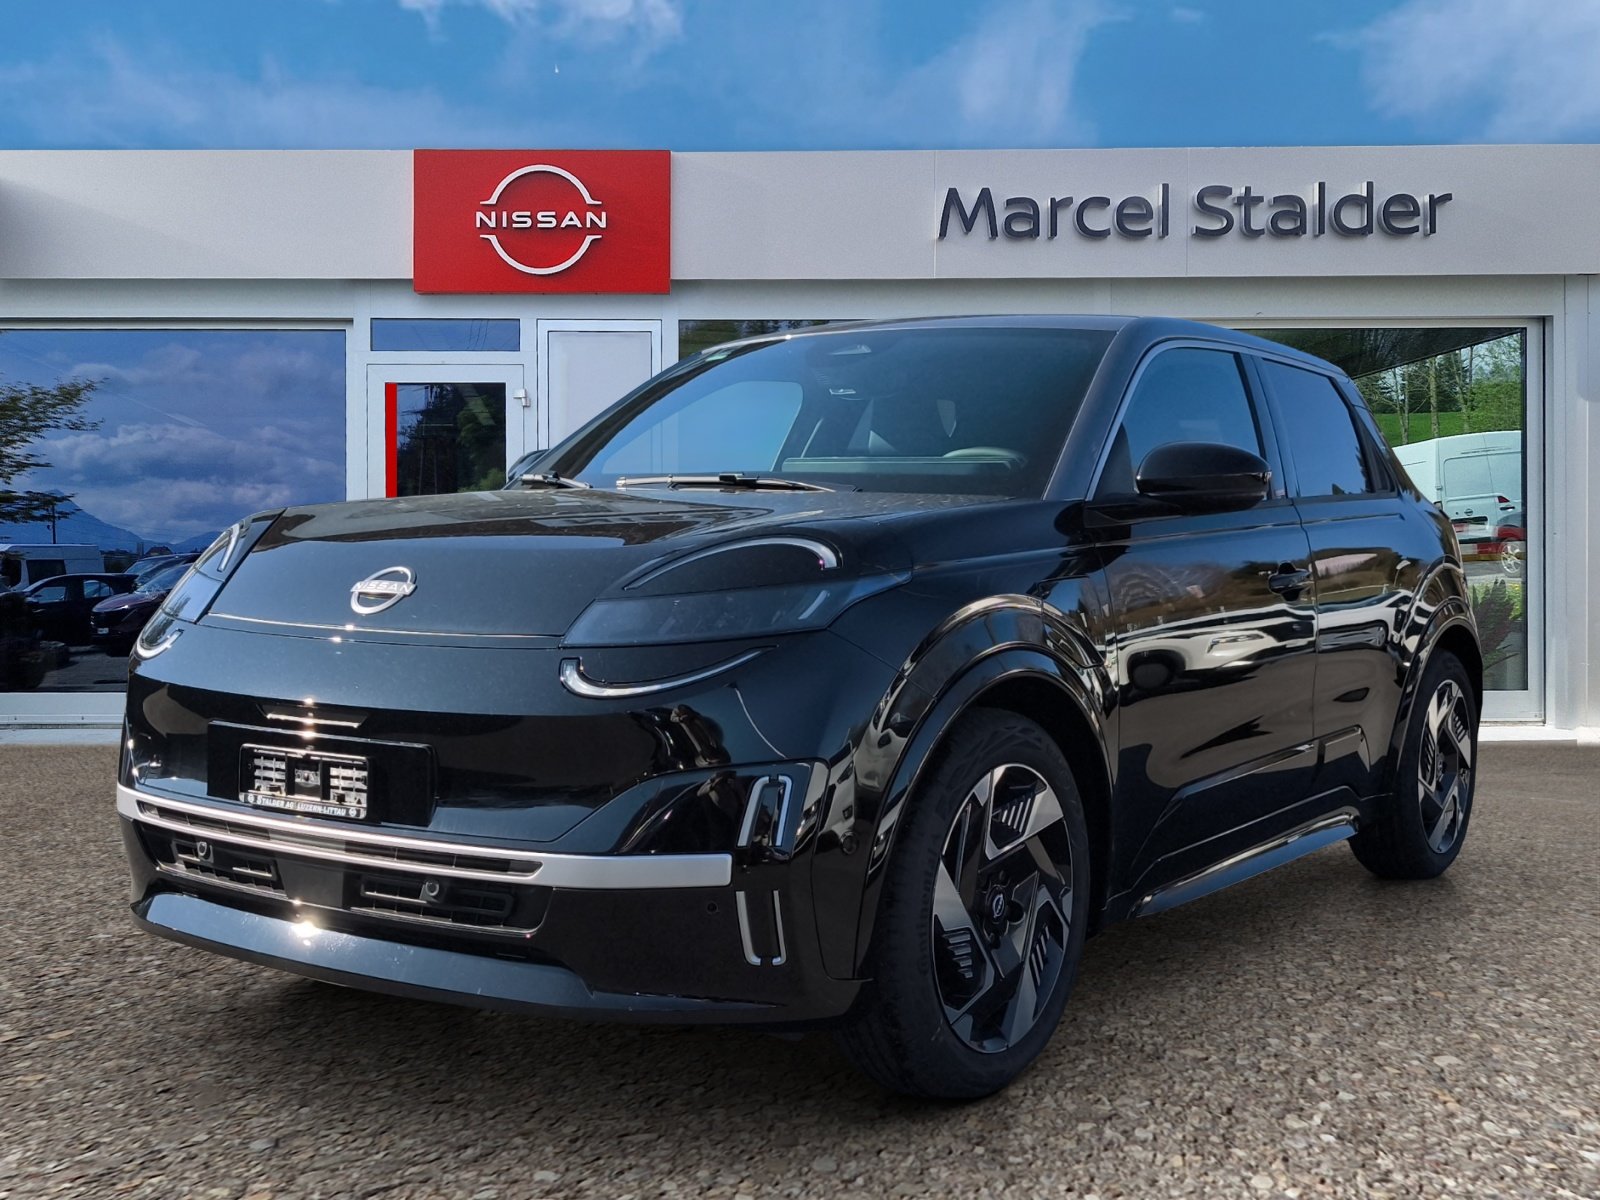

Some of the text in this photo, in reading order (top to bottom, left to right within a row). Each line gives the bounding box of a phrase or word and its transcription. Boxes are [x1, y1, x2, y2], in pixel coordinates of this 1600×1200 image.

[475, 211, 607, 228] NISSAN
[938, 181, 1453, 241] Marcel Stalder
[356, 581, 413, 592] NISSAN
